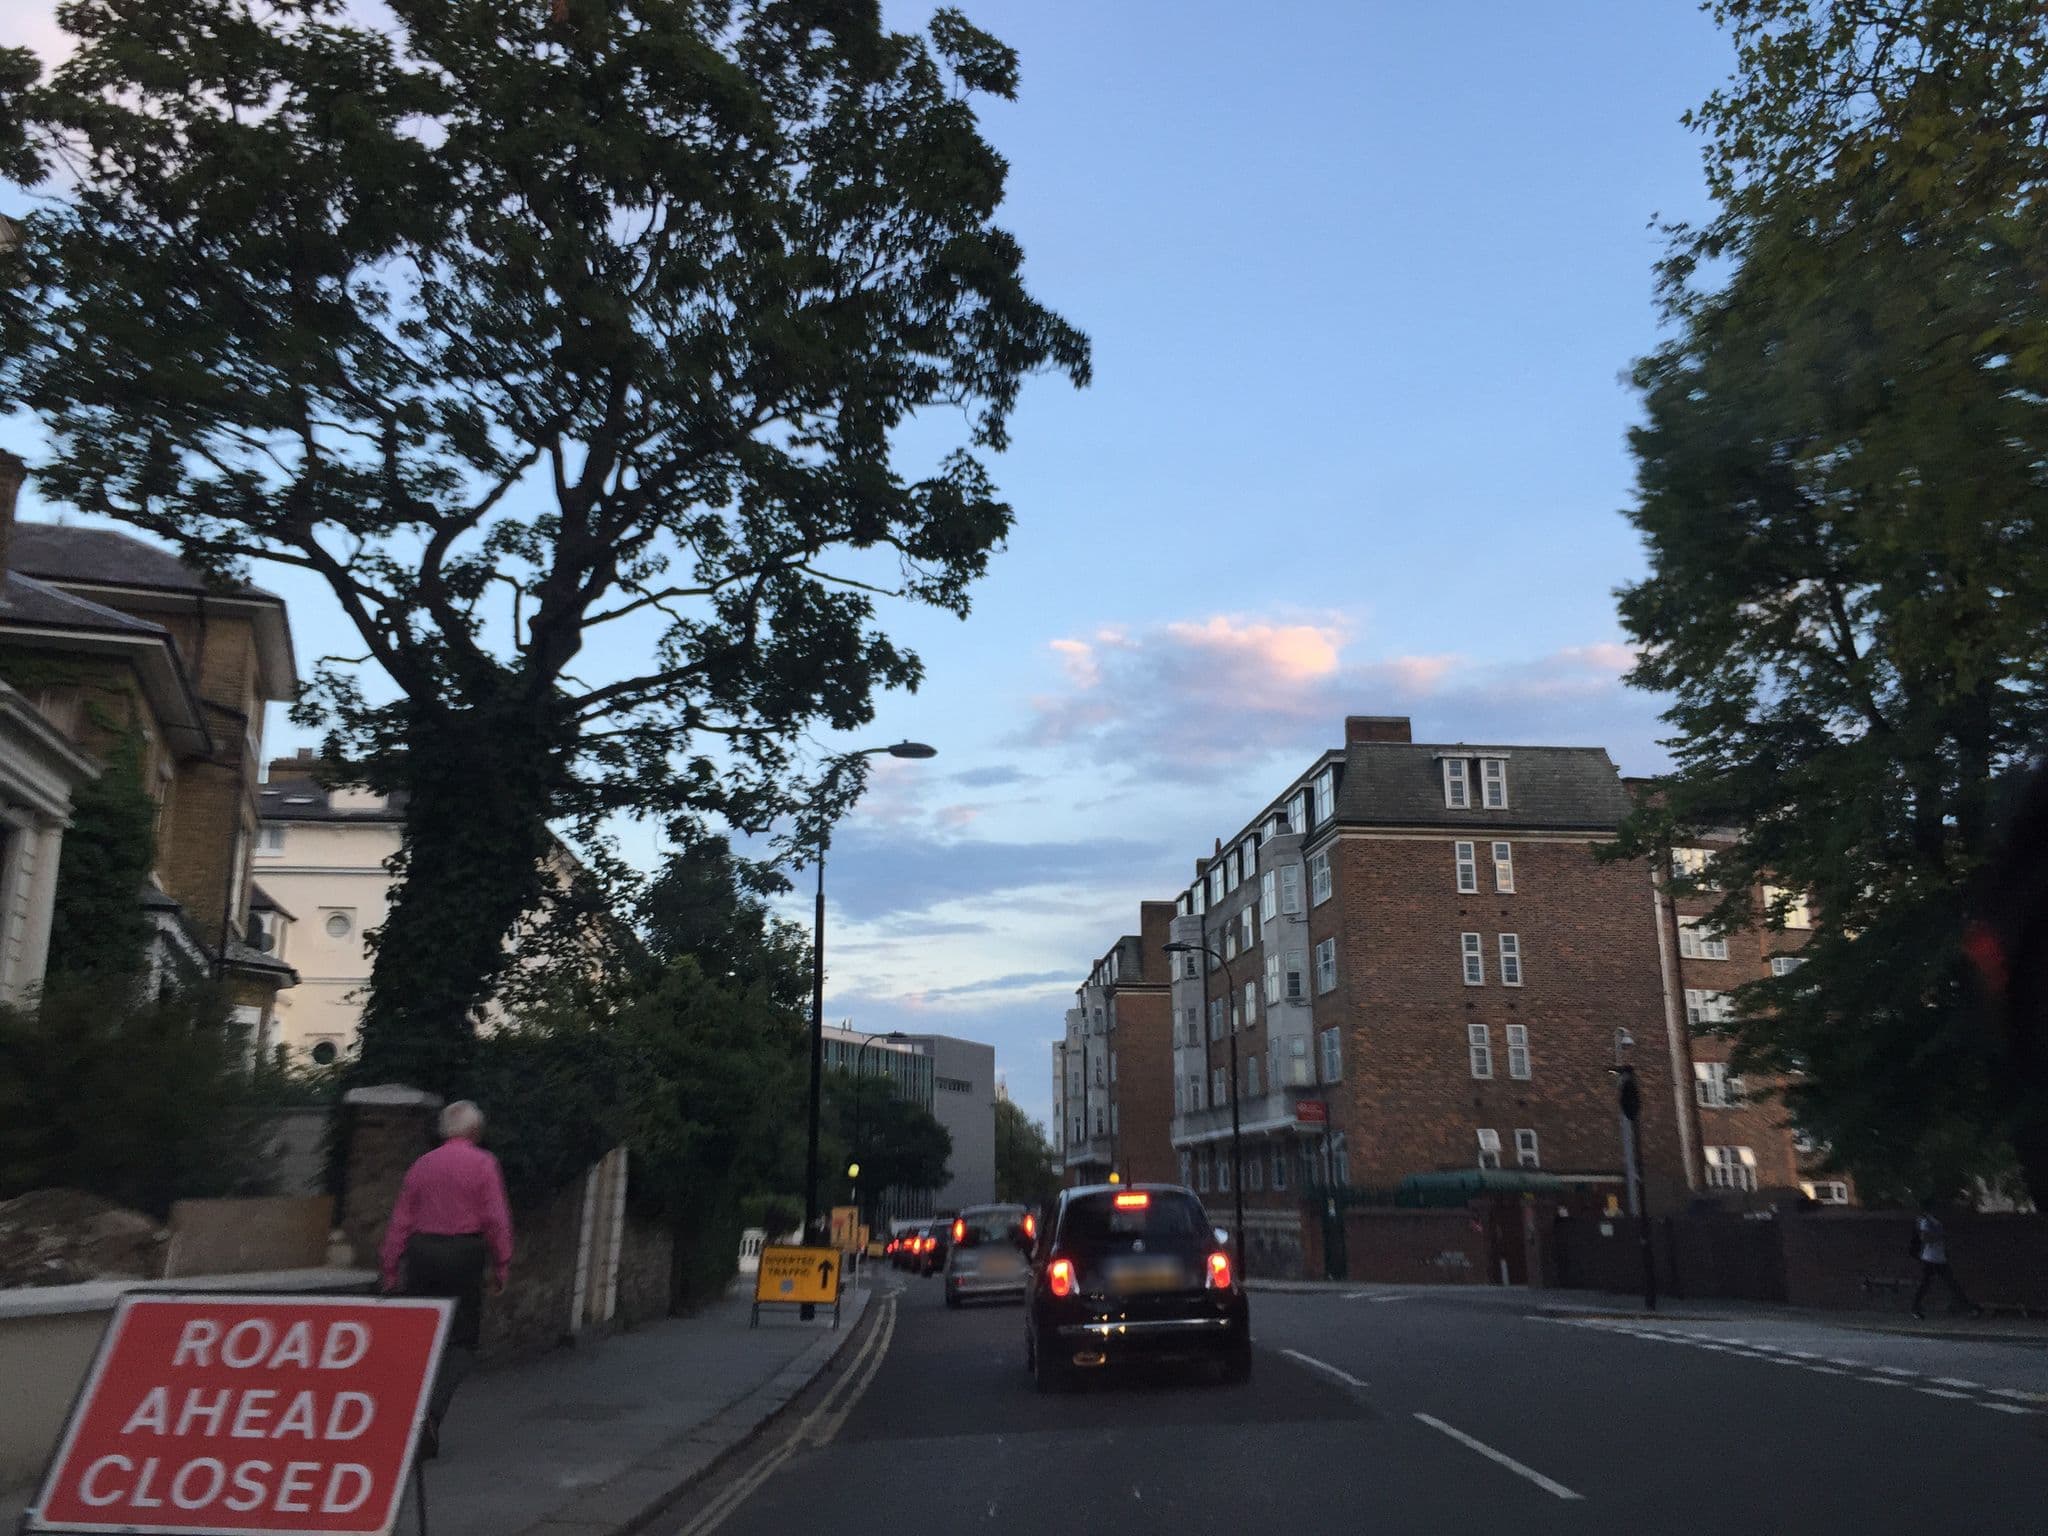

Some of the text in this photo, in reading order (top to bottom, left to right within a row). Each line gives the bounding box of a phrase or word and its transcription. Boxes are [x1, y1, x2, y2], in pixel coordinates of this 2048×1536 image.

[173, 1319, 370, 1369] ROAD
[120, 1386, 375, 1441] AHEAD
[79, 1454, 374, 1514] CLOSED
